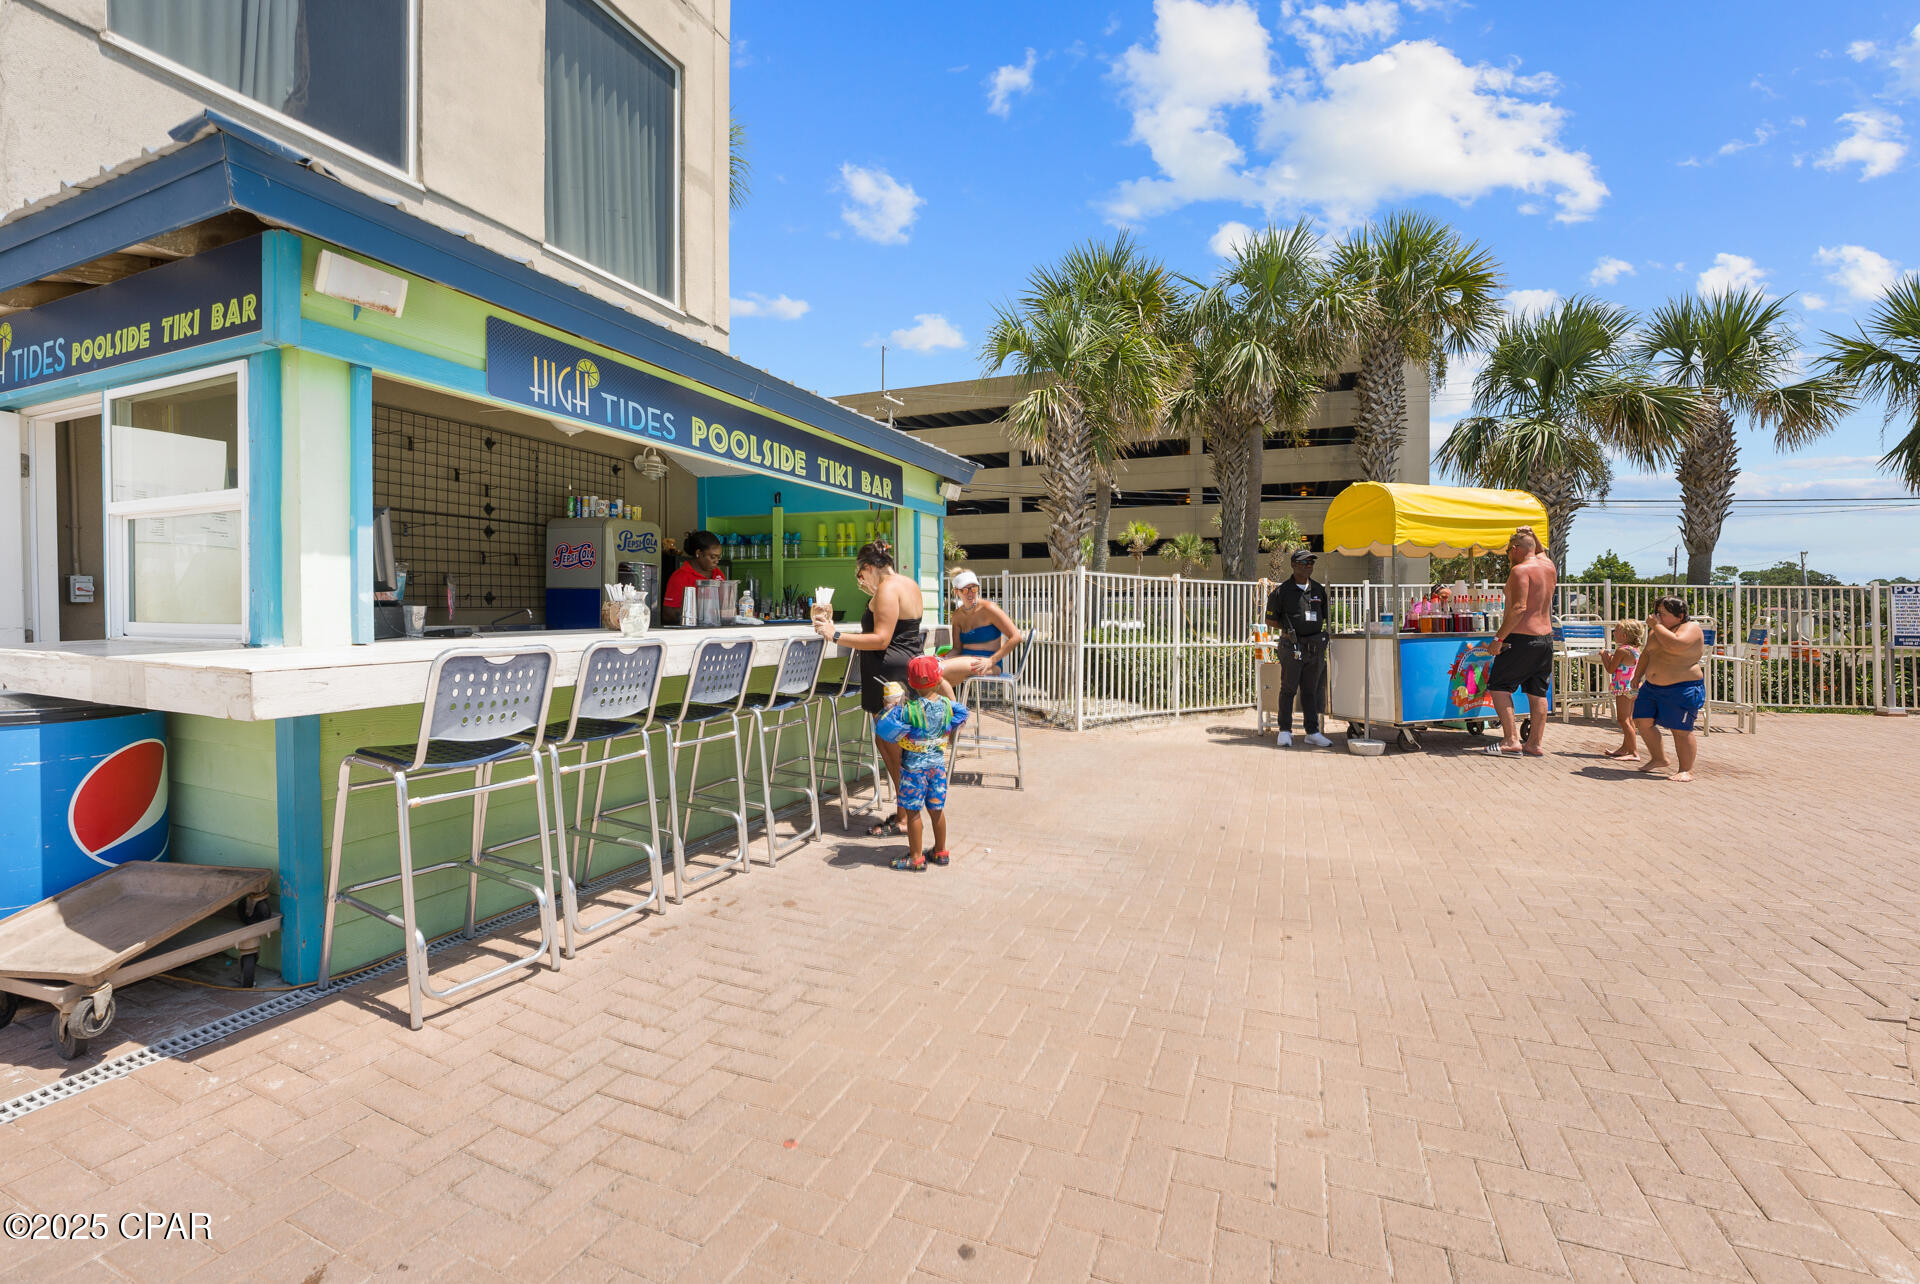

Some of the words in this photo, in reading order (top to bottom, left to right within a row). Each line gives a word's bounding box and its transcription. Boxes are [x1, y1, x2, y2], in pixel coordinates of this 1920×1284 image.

[12, 337, 66, 382] TIDES
[71, 322, 151, 366] POOLSIDE
[161, 308, 200, 343] TIKI
[211, 293, 257, 330] BAR
[529, 355, 590, 416] HIGH
[600, 392, 676, 440] TIDES
[691, 416, 807, 476] POOLSIDE
[817, 456, 853, 488] TIKI
[861, 470, 893, 500] BAR
[1893, 586, 1920, 594] PO
